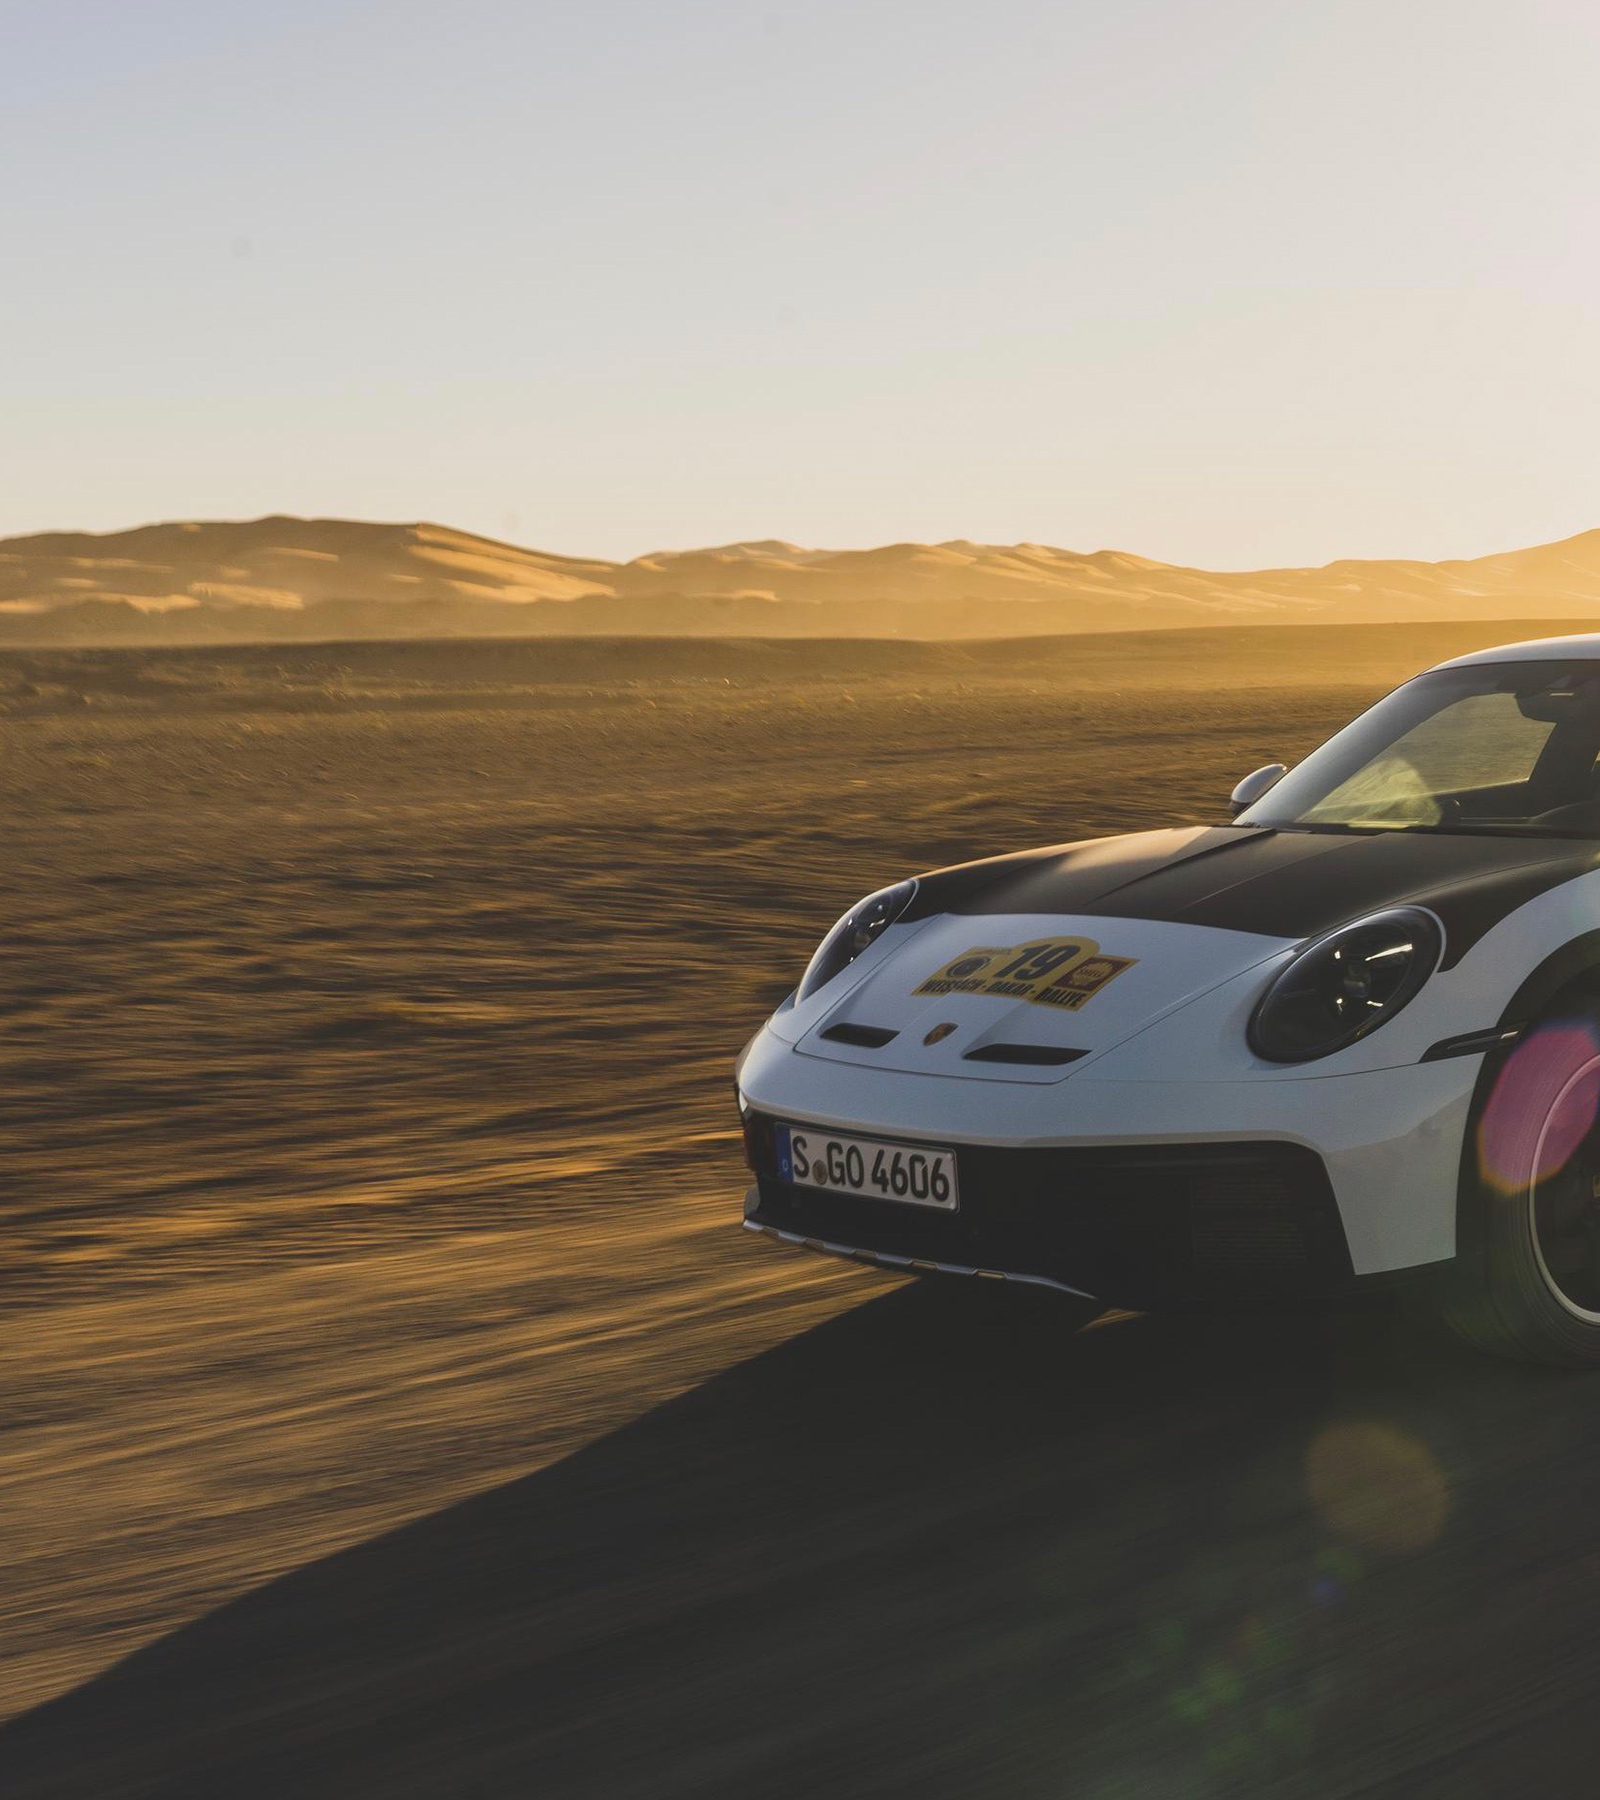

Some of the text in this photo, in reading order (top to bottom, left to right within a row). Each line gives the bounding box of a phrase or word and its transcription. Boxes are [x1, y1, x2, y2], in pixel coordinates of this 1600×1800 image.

[993, 943, 1082, 980] 19
[792, 1135, 950, 1202] S GO 4606
